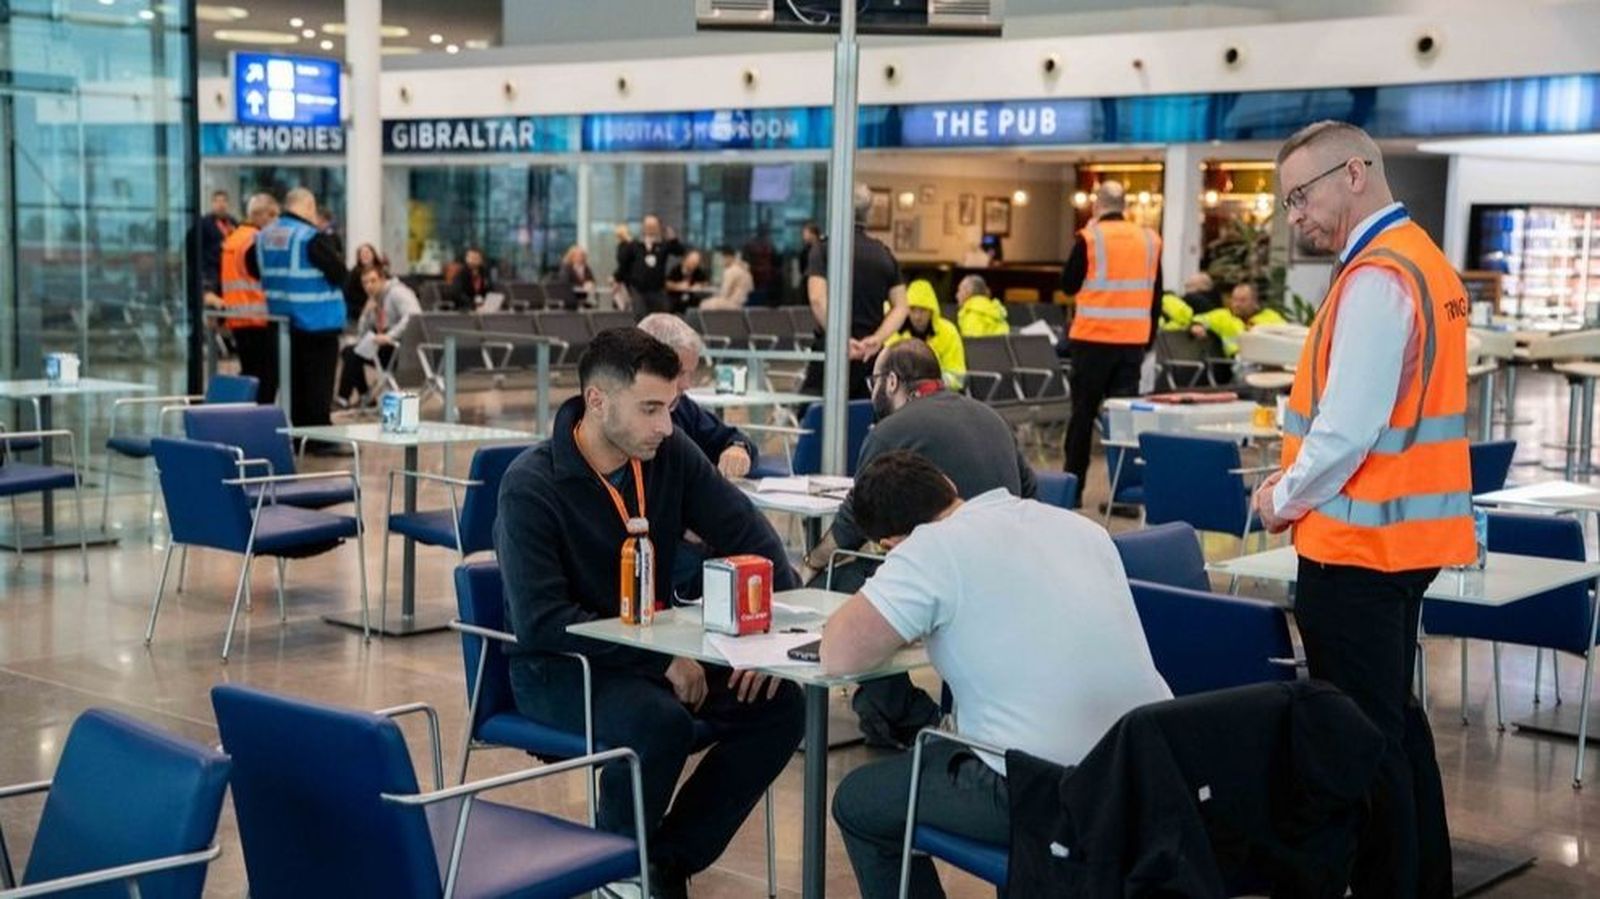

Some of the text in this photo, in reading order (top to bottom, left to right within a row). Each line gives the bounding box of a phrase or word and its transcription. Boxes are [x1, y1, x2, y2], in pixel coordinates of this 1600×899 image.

[227, 120, 536, 151] MEMORIES GIBRALTAR
[683, 118, 799, 142] SHROOM
[933, 106, 1057, 138] THE PUB
